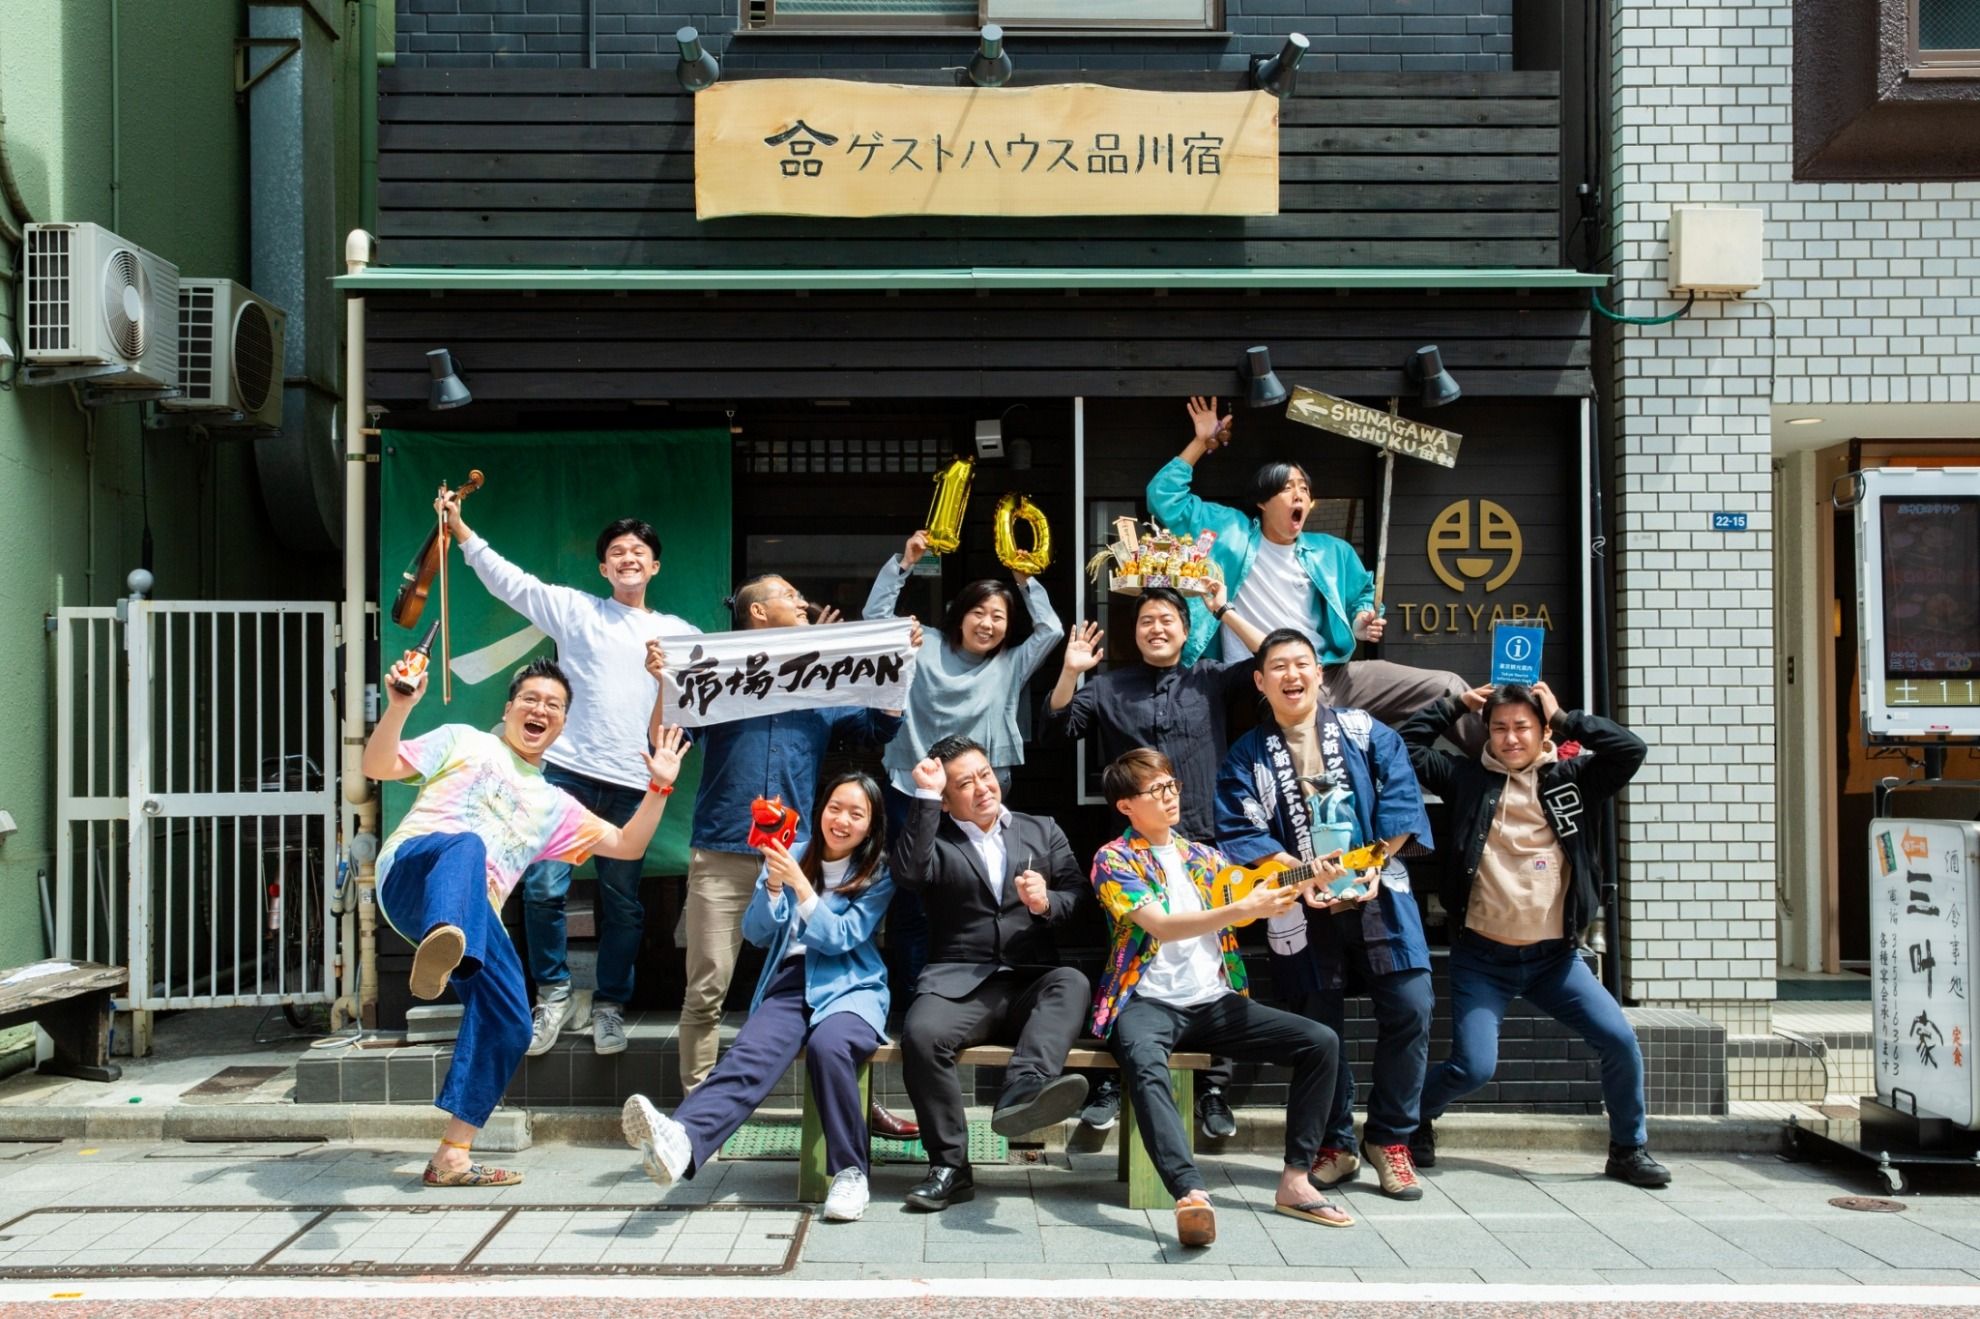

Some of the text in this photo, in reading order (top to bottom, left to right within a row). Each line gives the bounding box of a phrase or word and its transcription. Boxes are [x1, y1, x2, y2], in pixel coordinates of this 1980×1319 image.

[845, 131, 1225, 177] ゲストハウス品川宿
[1331, 404, 1449, 450] SHINAGAWA
[1348, 423, 1417, 453] SHUKU
[1715, 515, 1746, 528] 22-15
[1397, 603, 1554, 633] TOIYABA
